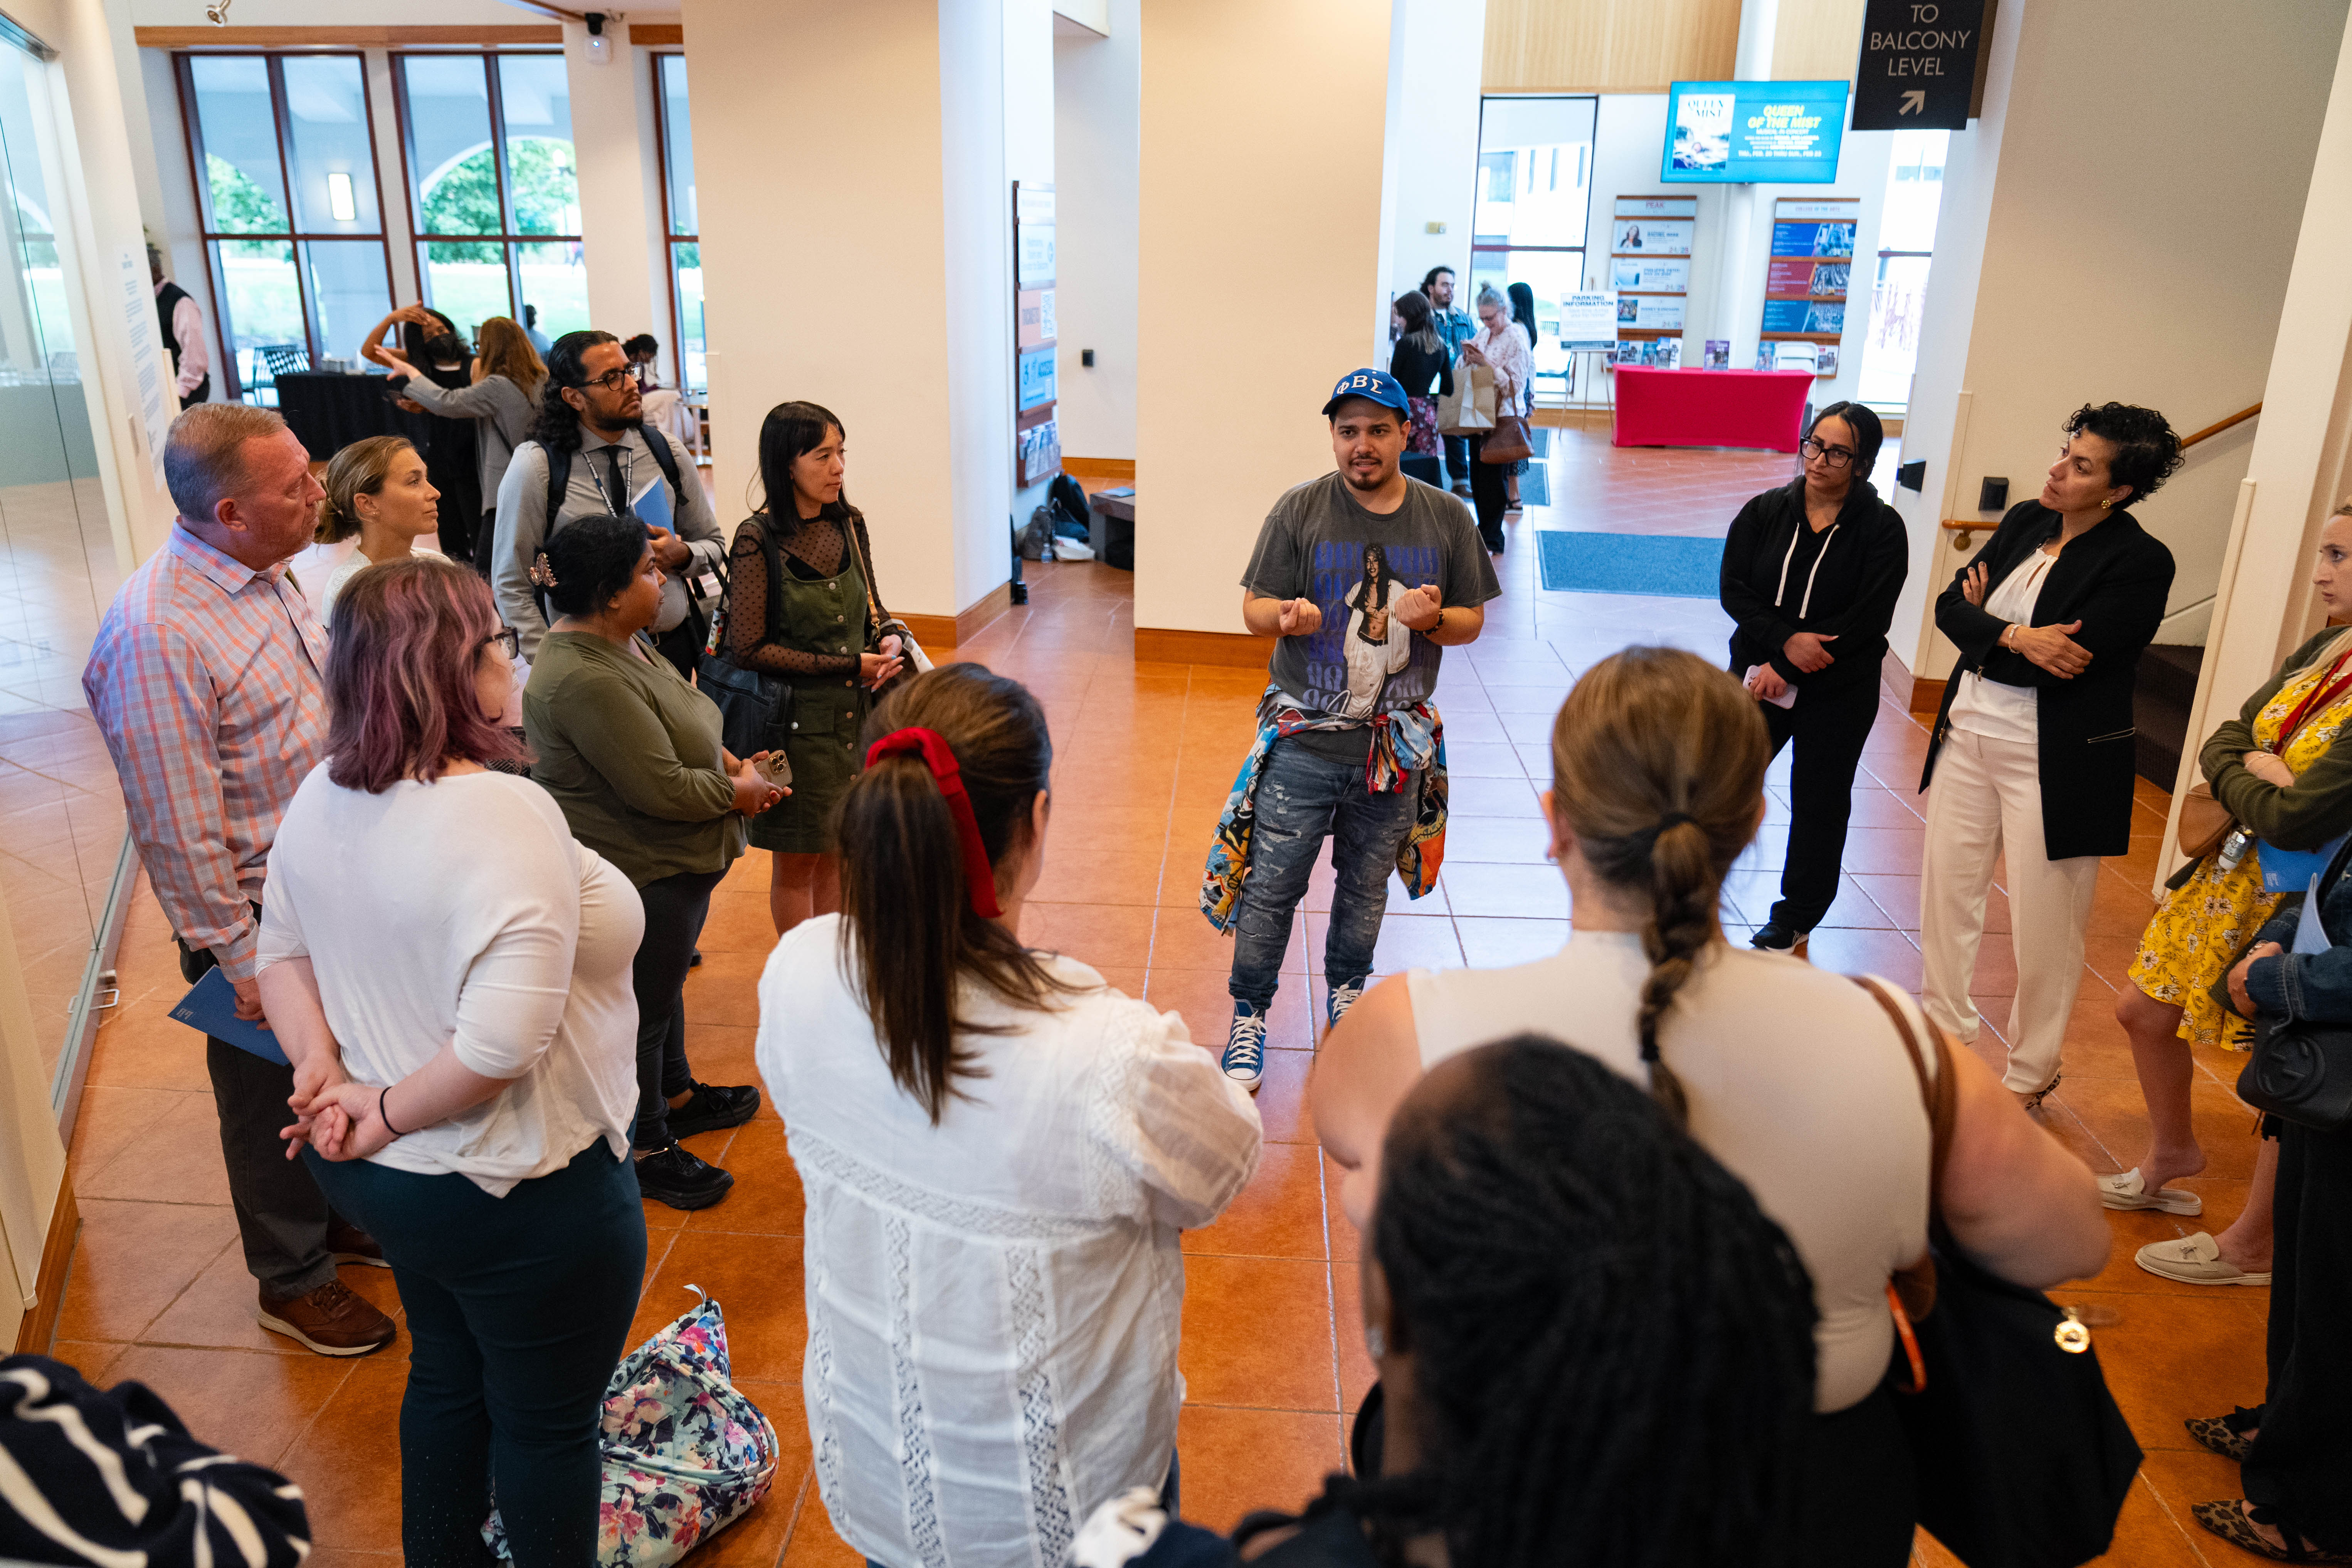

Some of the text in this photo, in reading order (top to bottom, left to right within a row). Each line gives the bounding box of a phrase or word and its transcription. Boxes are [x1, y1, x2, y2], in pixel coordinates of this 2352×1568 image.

[1910, 4, 1939, 24] TO
[1870, 30, 1971, 50] BALCONY
[1888, 57, 1944, 76] LEVEL
[1764, 105, 1805, 117] QUEEN
[1747, 116, 1822, 129] OF THE MIST
[589, 463, 599, 479] Newark
[600, 486, 612, 508] Education
